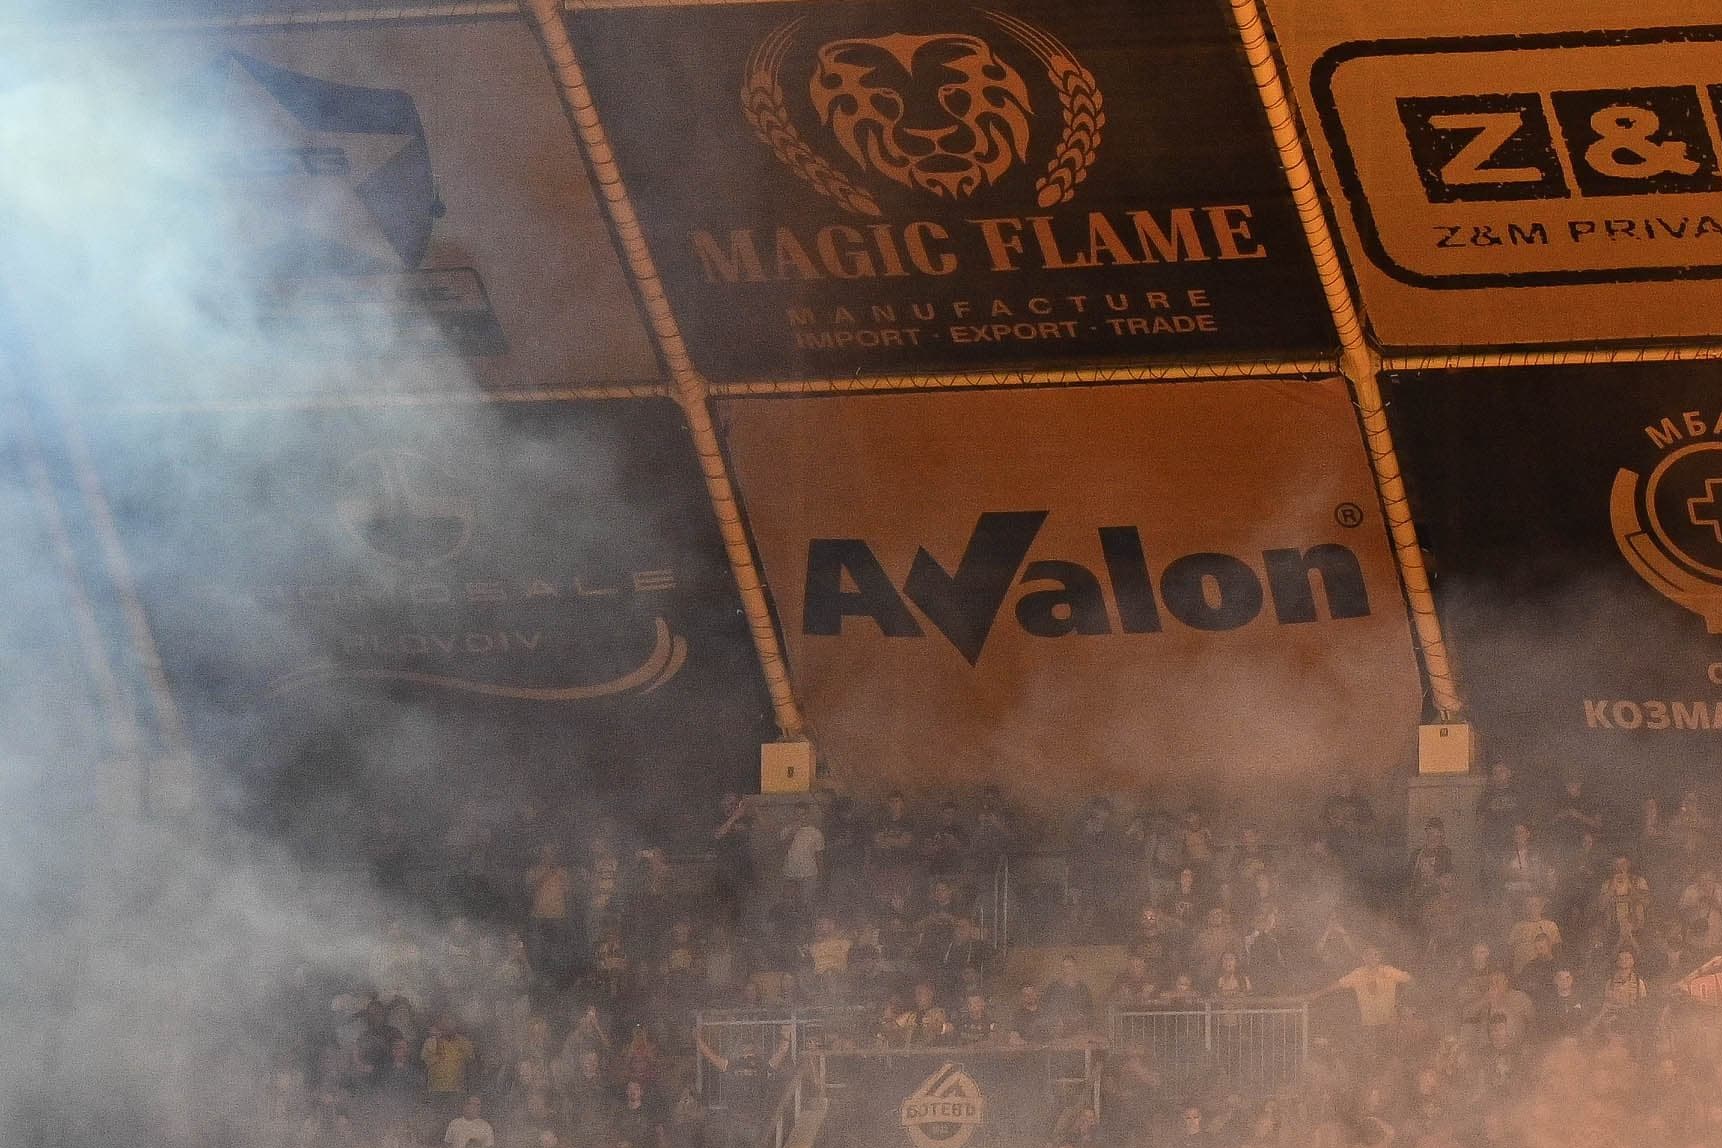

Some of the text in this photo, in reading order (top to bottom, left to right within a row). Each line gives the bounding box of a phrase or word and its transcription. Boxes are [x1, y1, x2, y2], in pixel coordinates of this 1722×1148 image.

[690, 203, 1268, 284] MAGIC FLAME
[1433, 222, 1549, 249] Z&M
[788, 289, 1212, 327] MANUFACTURE
[797, 313, 1219, 351] IMPORT EXPORT TRADE
